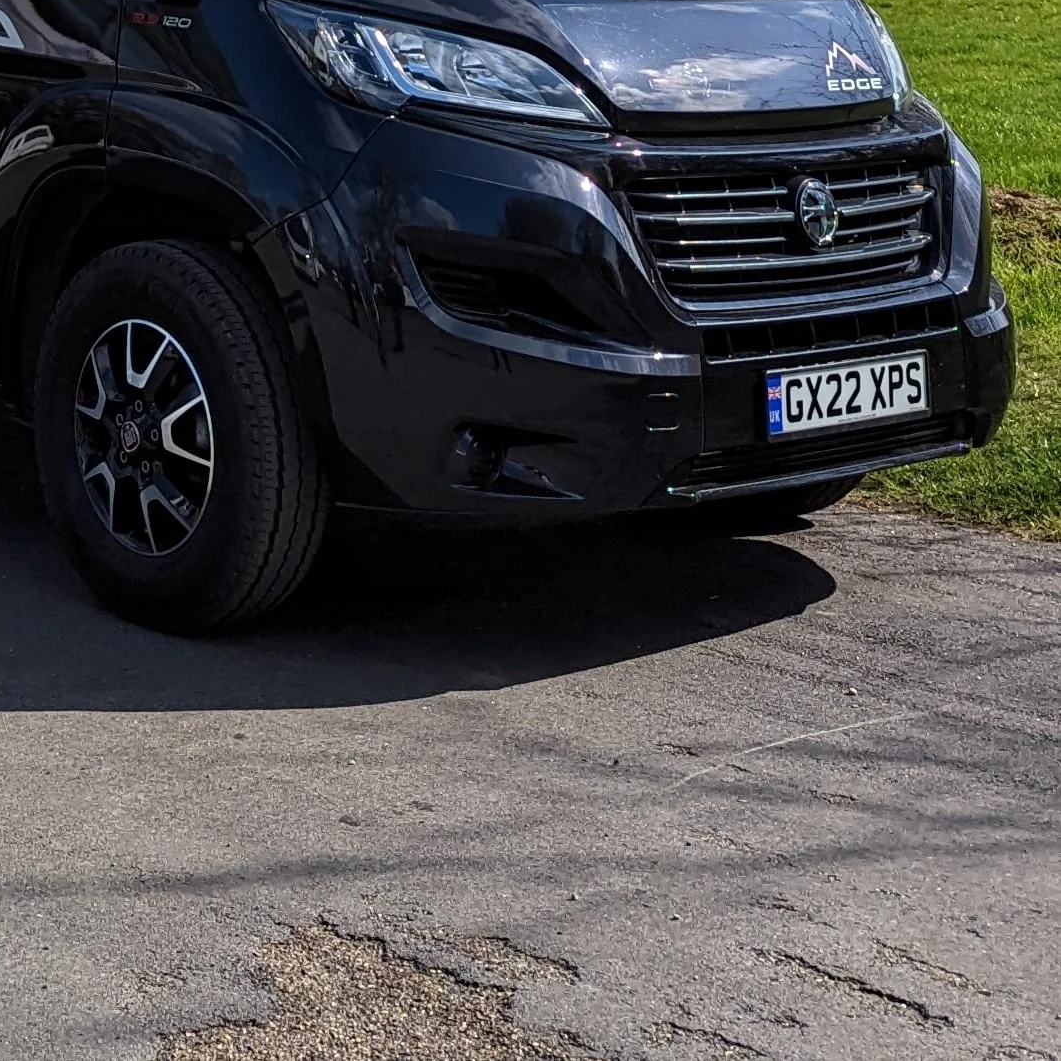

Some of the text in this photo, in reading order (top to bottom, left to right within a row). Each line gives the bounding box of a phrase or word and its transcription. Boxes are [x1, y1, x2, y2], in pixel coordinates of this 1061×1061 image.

[162, 15, 192, 28] 120
[826, 78, 883, 91] EDGE
[785, 361, 922, 424] GX22 XPS
[769, 410, 781, 423] UK
